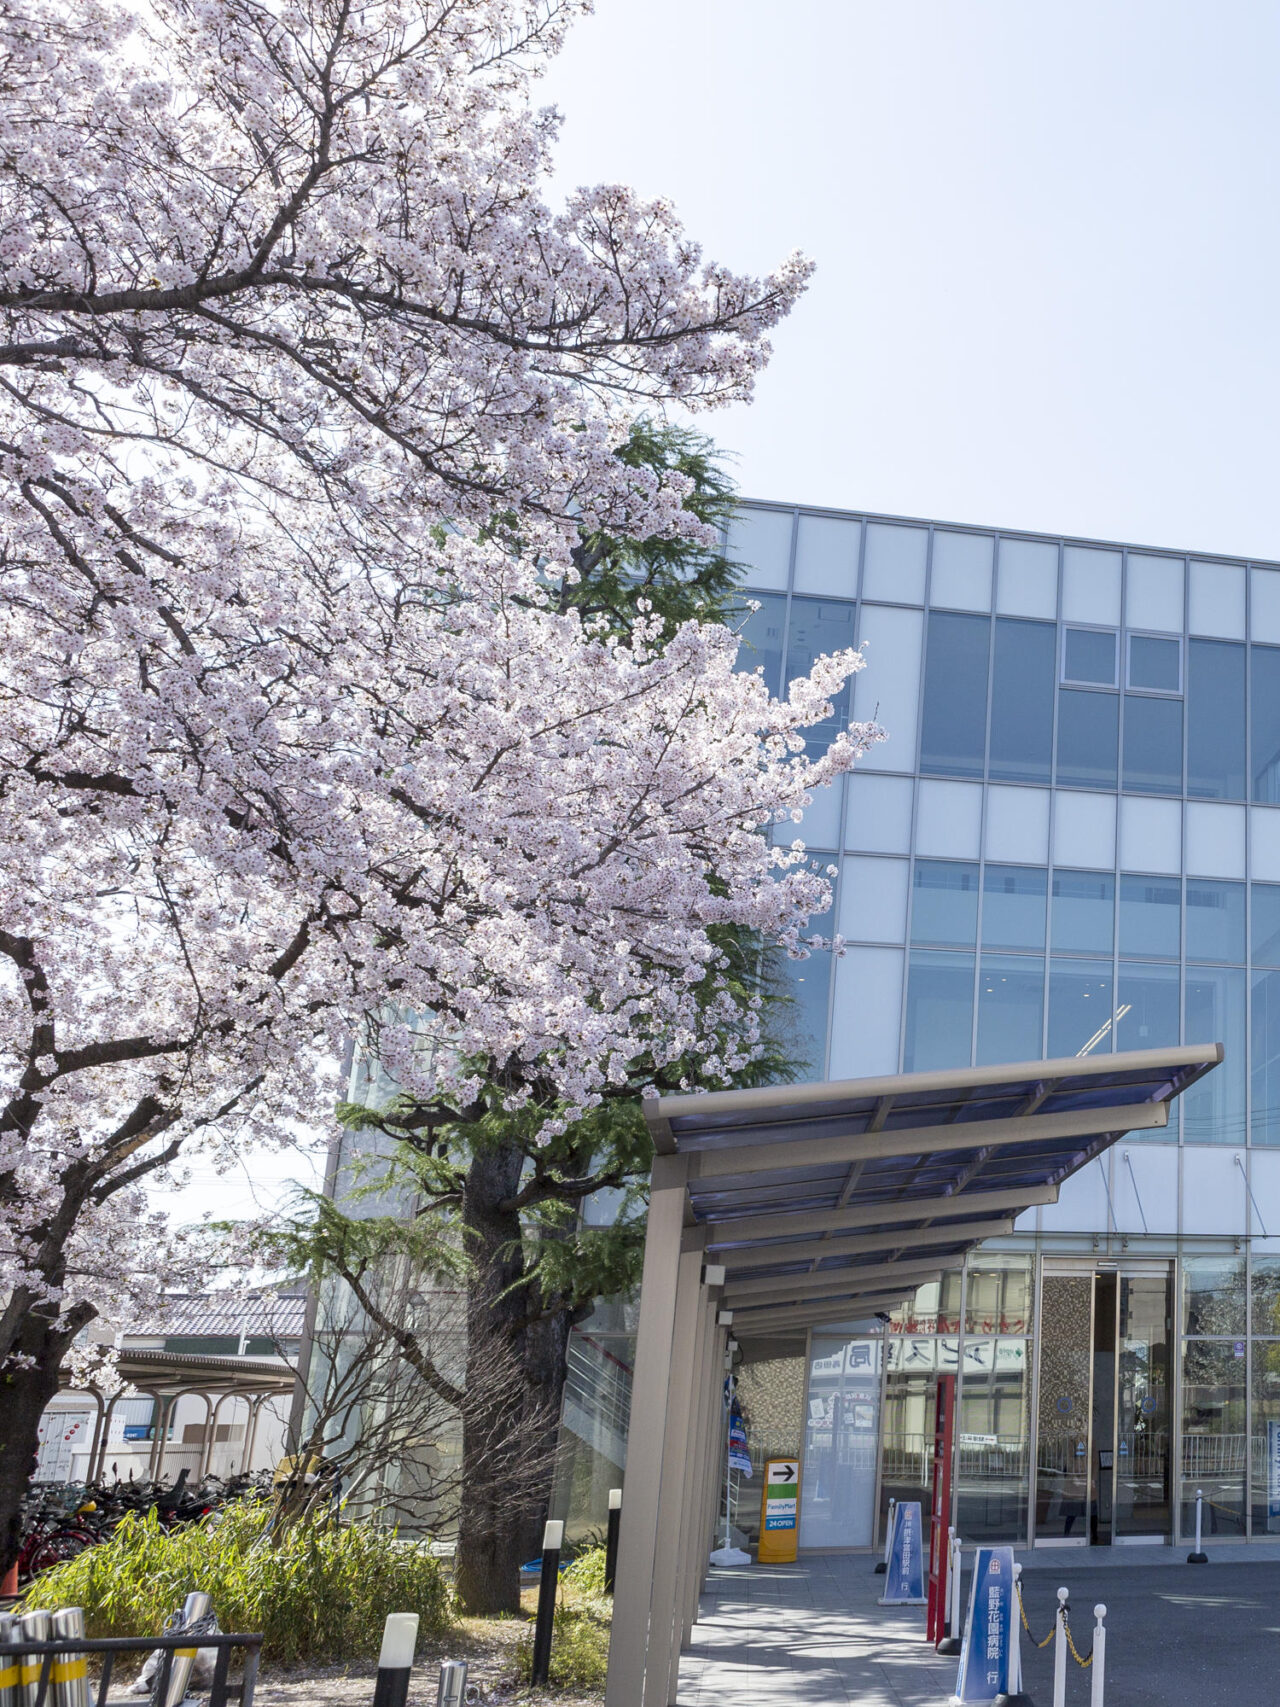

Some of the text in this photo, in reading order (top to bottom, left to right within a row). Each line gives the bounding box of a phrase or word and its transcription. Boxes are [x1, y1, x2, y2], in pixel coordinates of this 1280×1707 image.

[767, 1502, 796, 1510] FamilyMart
[986, 1586, 1000, 1685] 藍野花園病院 行
